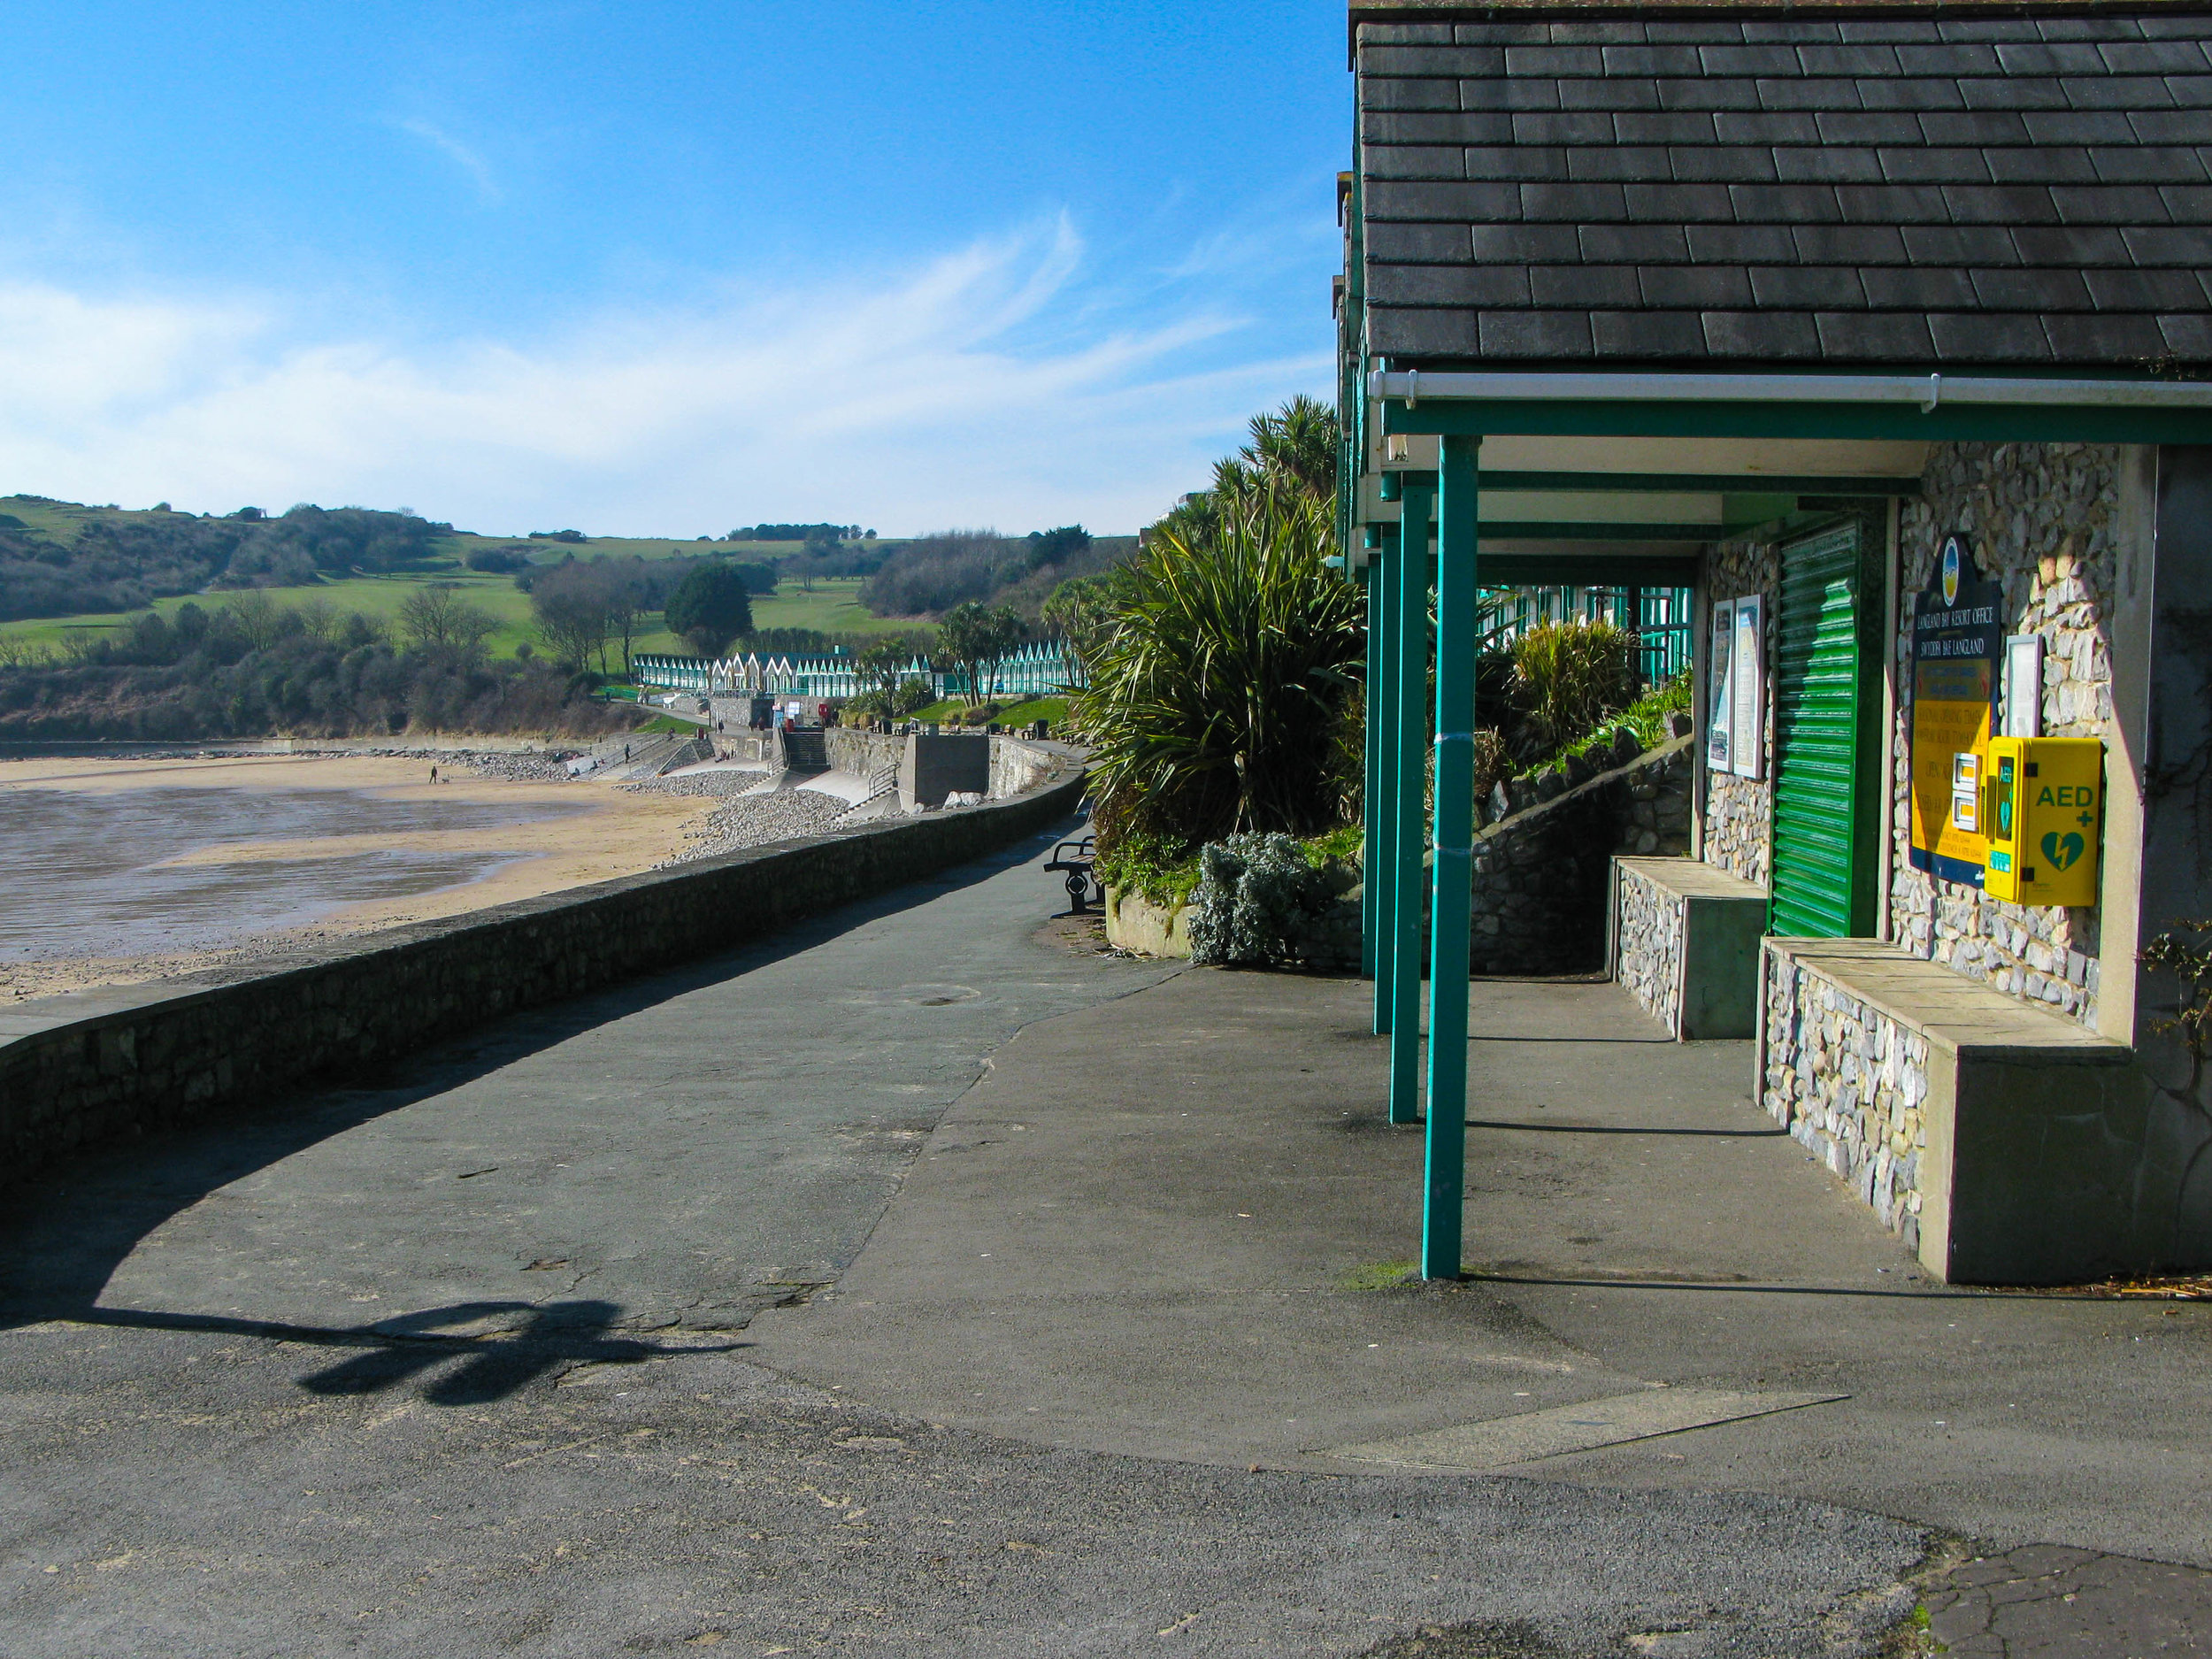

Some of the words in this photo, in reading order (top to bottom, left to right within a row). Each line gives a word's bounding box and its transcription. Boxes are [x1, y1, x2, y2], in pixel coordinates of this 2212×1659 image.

[1917, 613, 1940, 629] LANGLAND
[1941, 611, 1950, 627] BAY
[1951, 610, 1970, 626] RESORT
[1972, 607, 1993, 624] OFFICE
[1953, 638, 1984, 654] LANGLAND
[2036, 786, 2093, 807] AED
